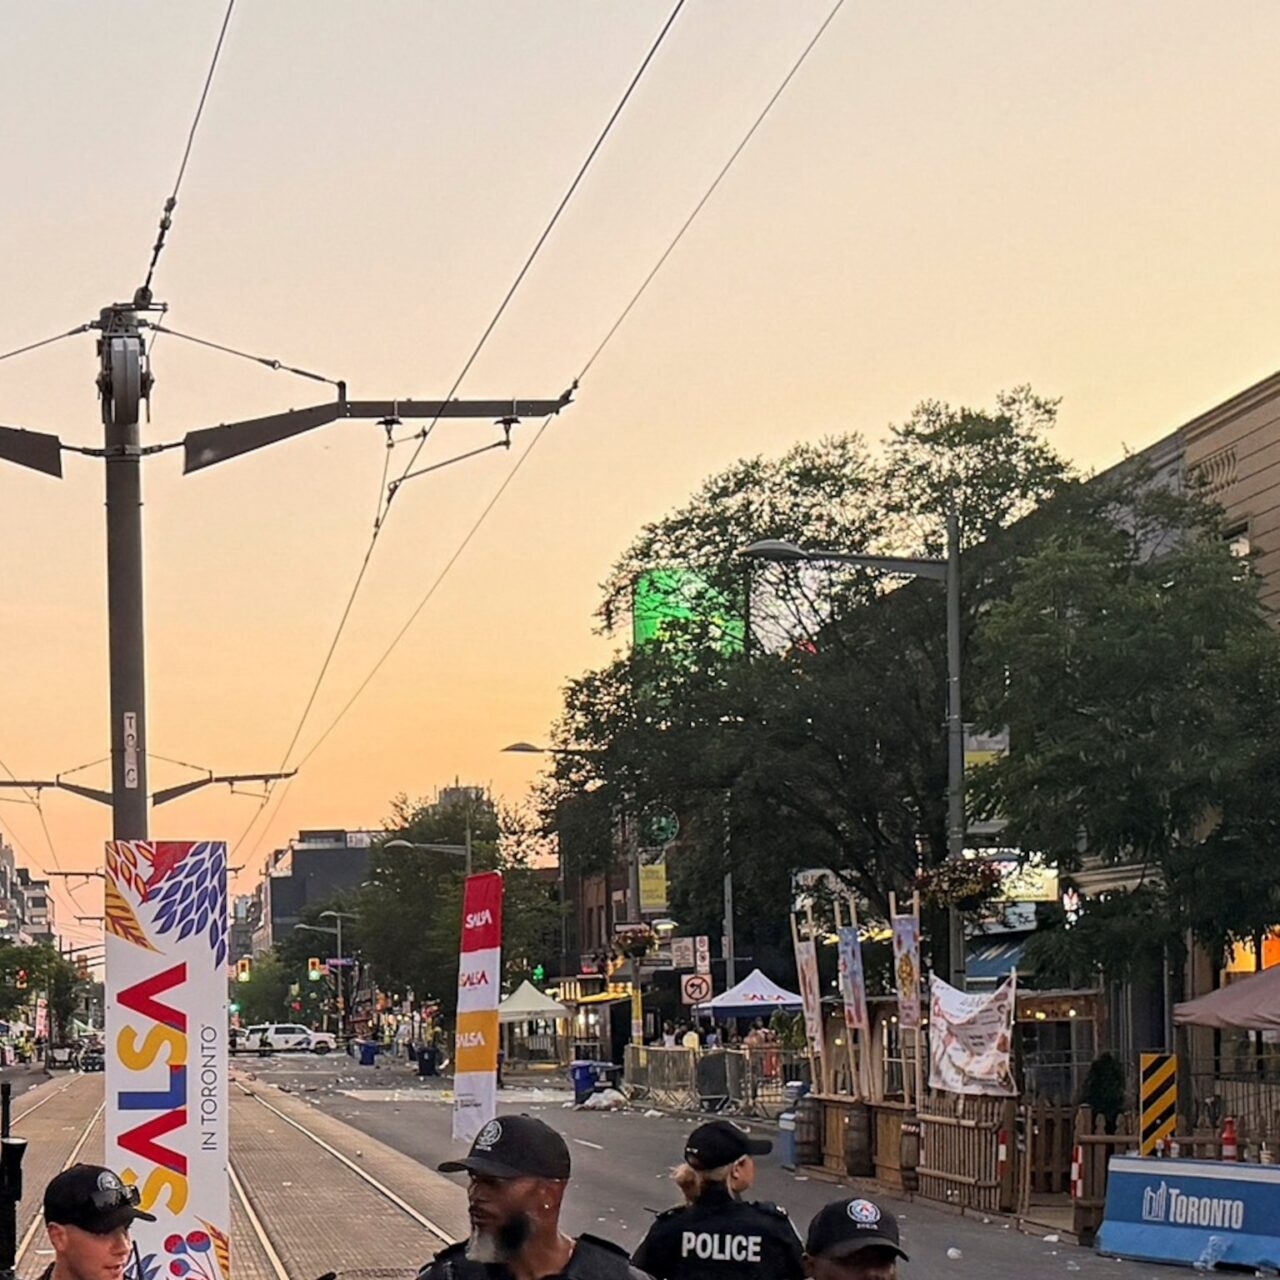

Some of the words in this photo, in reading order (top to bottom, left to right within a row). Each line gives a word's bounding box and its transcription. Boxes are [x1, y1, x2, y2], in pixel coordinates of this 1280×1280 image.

[465, 909, 492, 929] SALSA
[459, 970, 488, 987] SALSA
[200, 1025, 218, 1125] TORONTO
[201, 1130, 218, 1150] IN
[1168, 1187, 1244, 1229] TORONTO
[682, 1231, 762, 1262] POLICE
